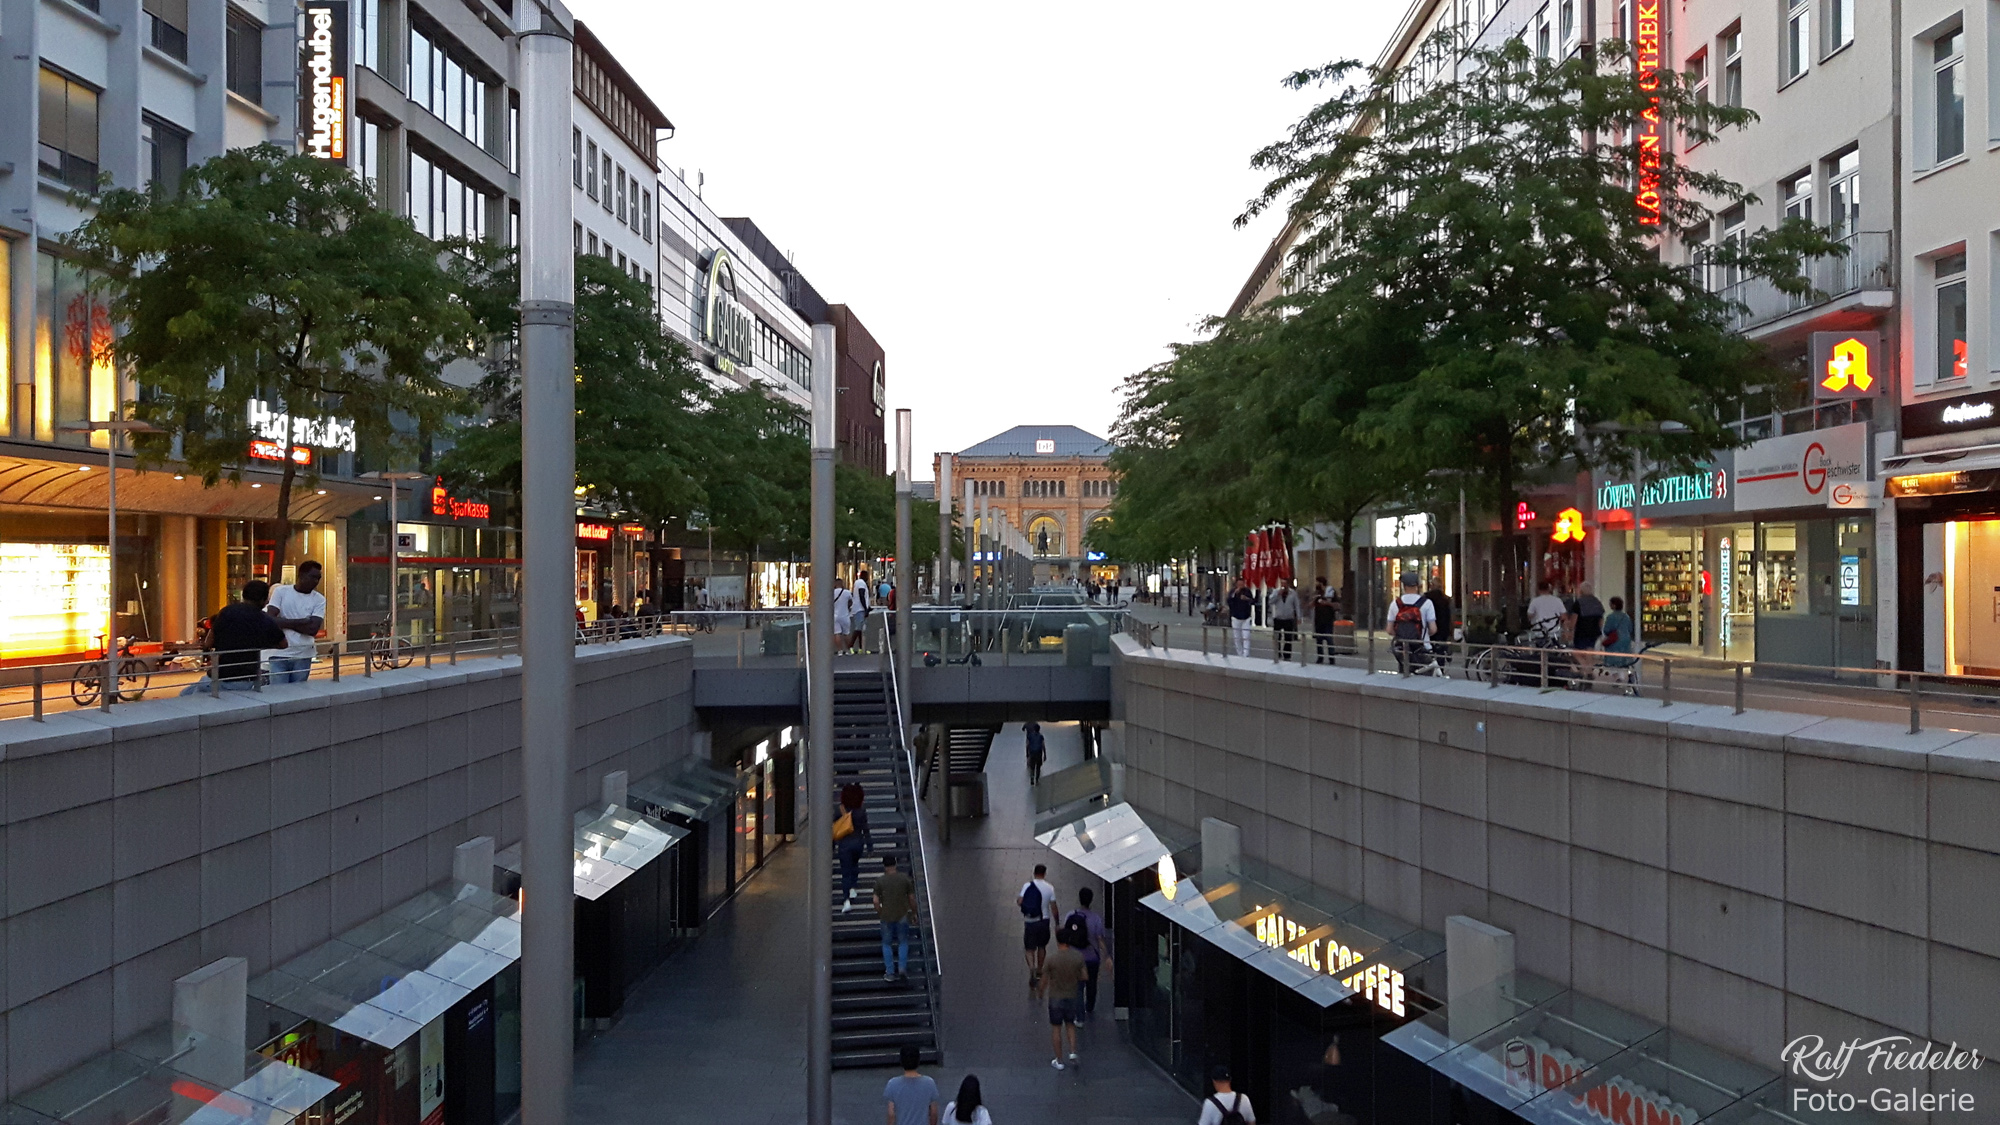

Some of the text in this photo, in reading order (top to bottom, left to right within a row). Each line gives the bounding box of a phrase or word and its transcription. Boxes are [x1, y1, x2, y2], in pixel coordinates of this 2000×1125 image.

[308, 8, 332, 159] Hugendubel
[717, 299, 753, 367] GALERIA
[449, 497, 489, 520] Sparkasse
[1255, 905, 1406, 1018] BALZAC COFFEE
